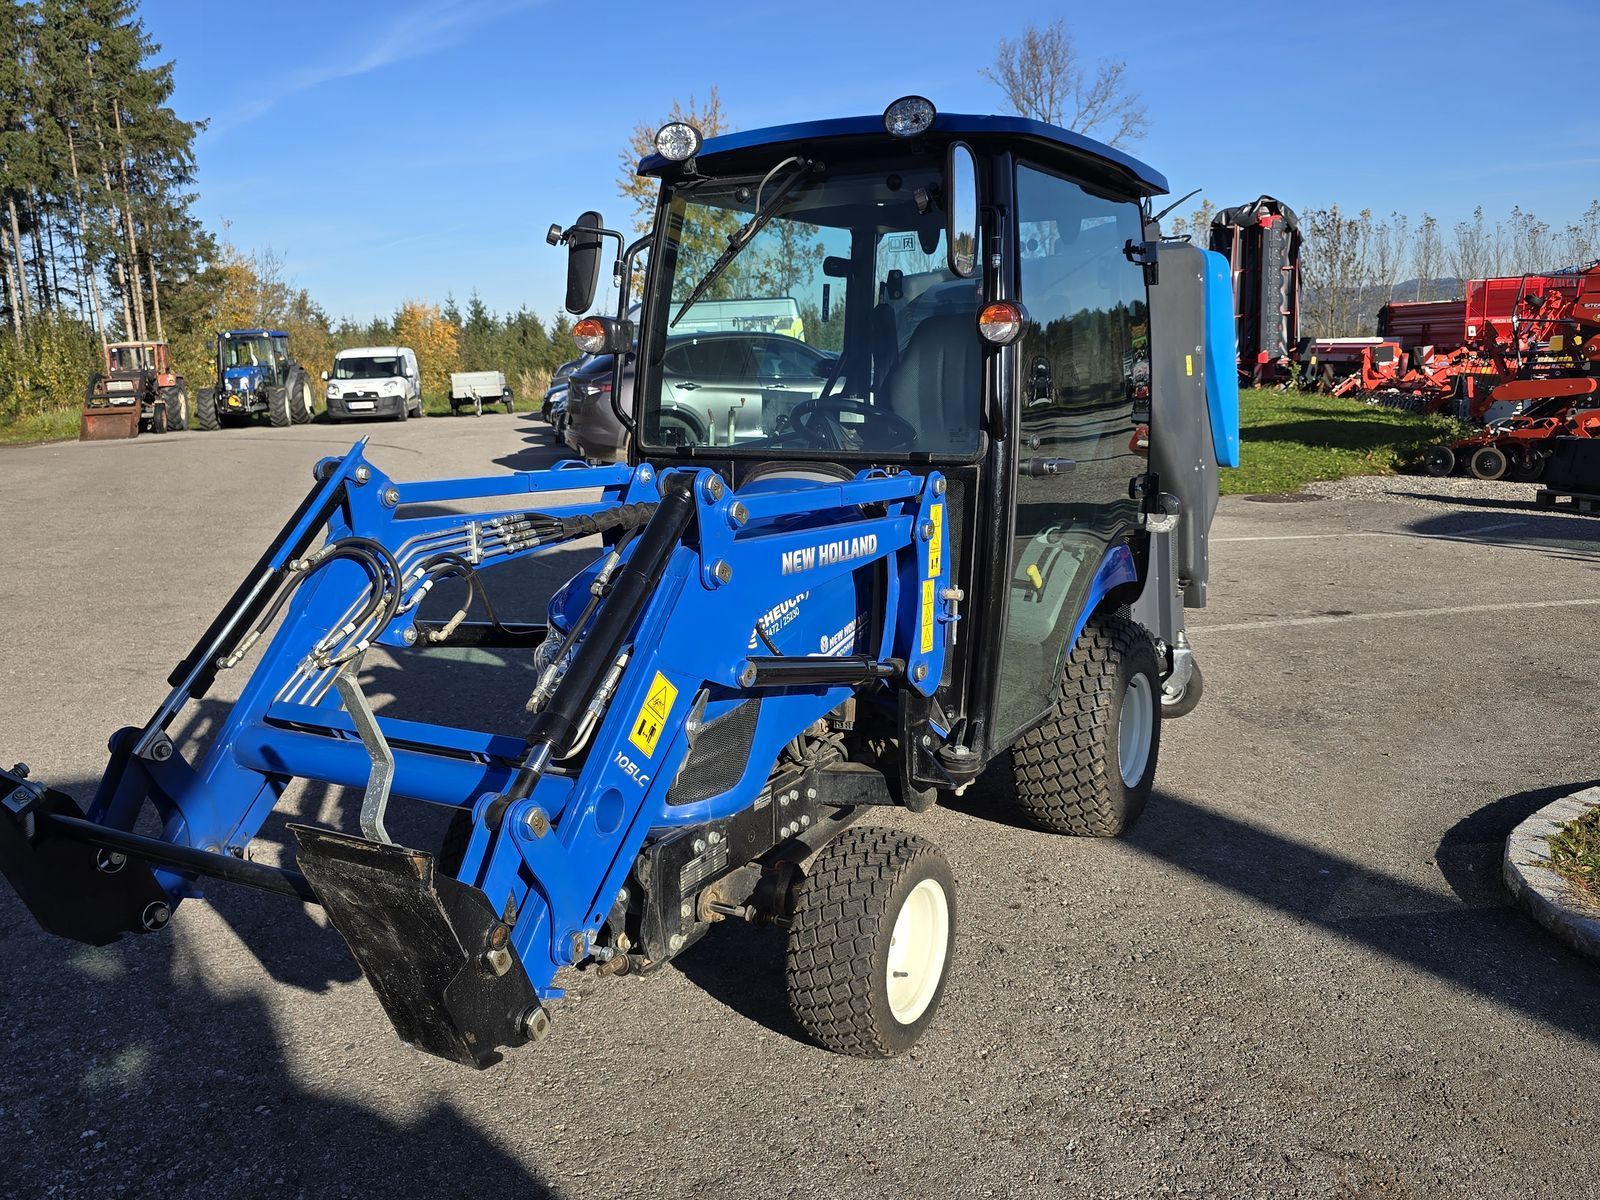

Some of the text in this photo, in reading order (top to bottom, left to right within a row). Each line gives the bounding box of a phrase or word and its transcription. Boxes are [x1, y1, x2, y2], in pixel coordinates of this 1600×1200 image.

[782, 534, 878, 576] NEW HOLLAND
[613, 750, 650, 787] 105LC
